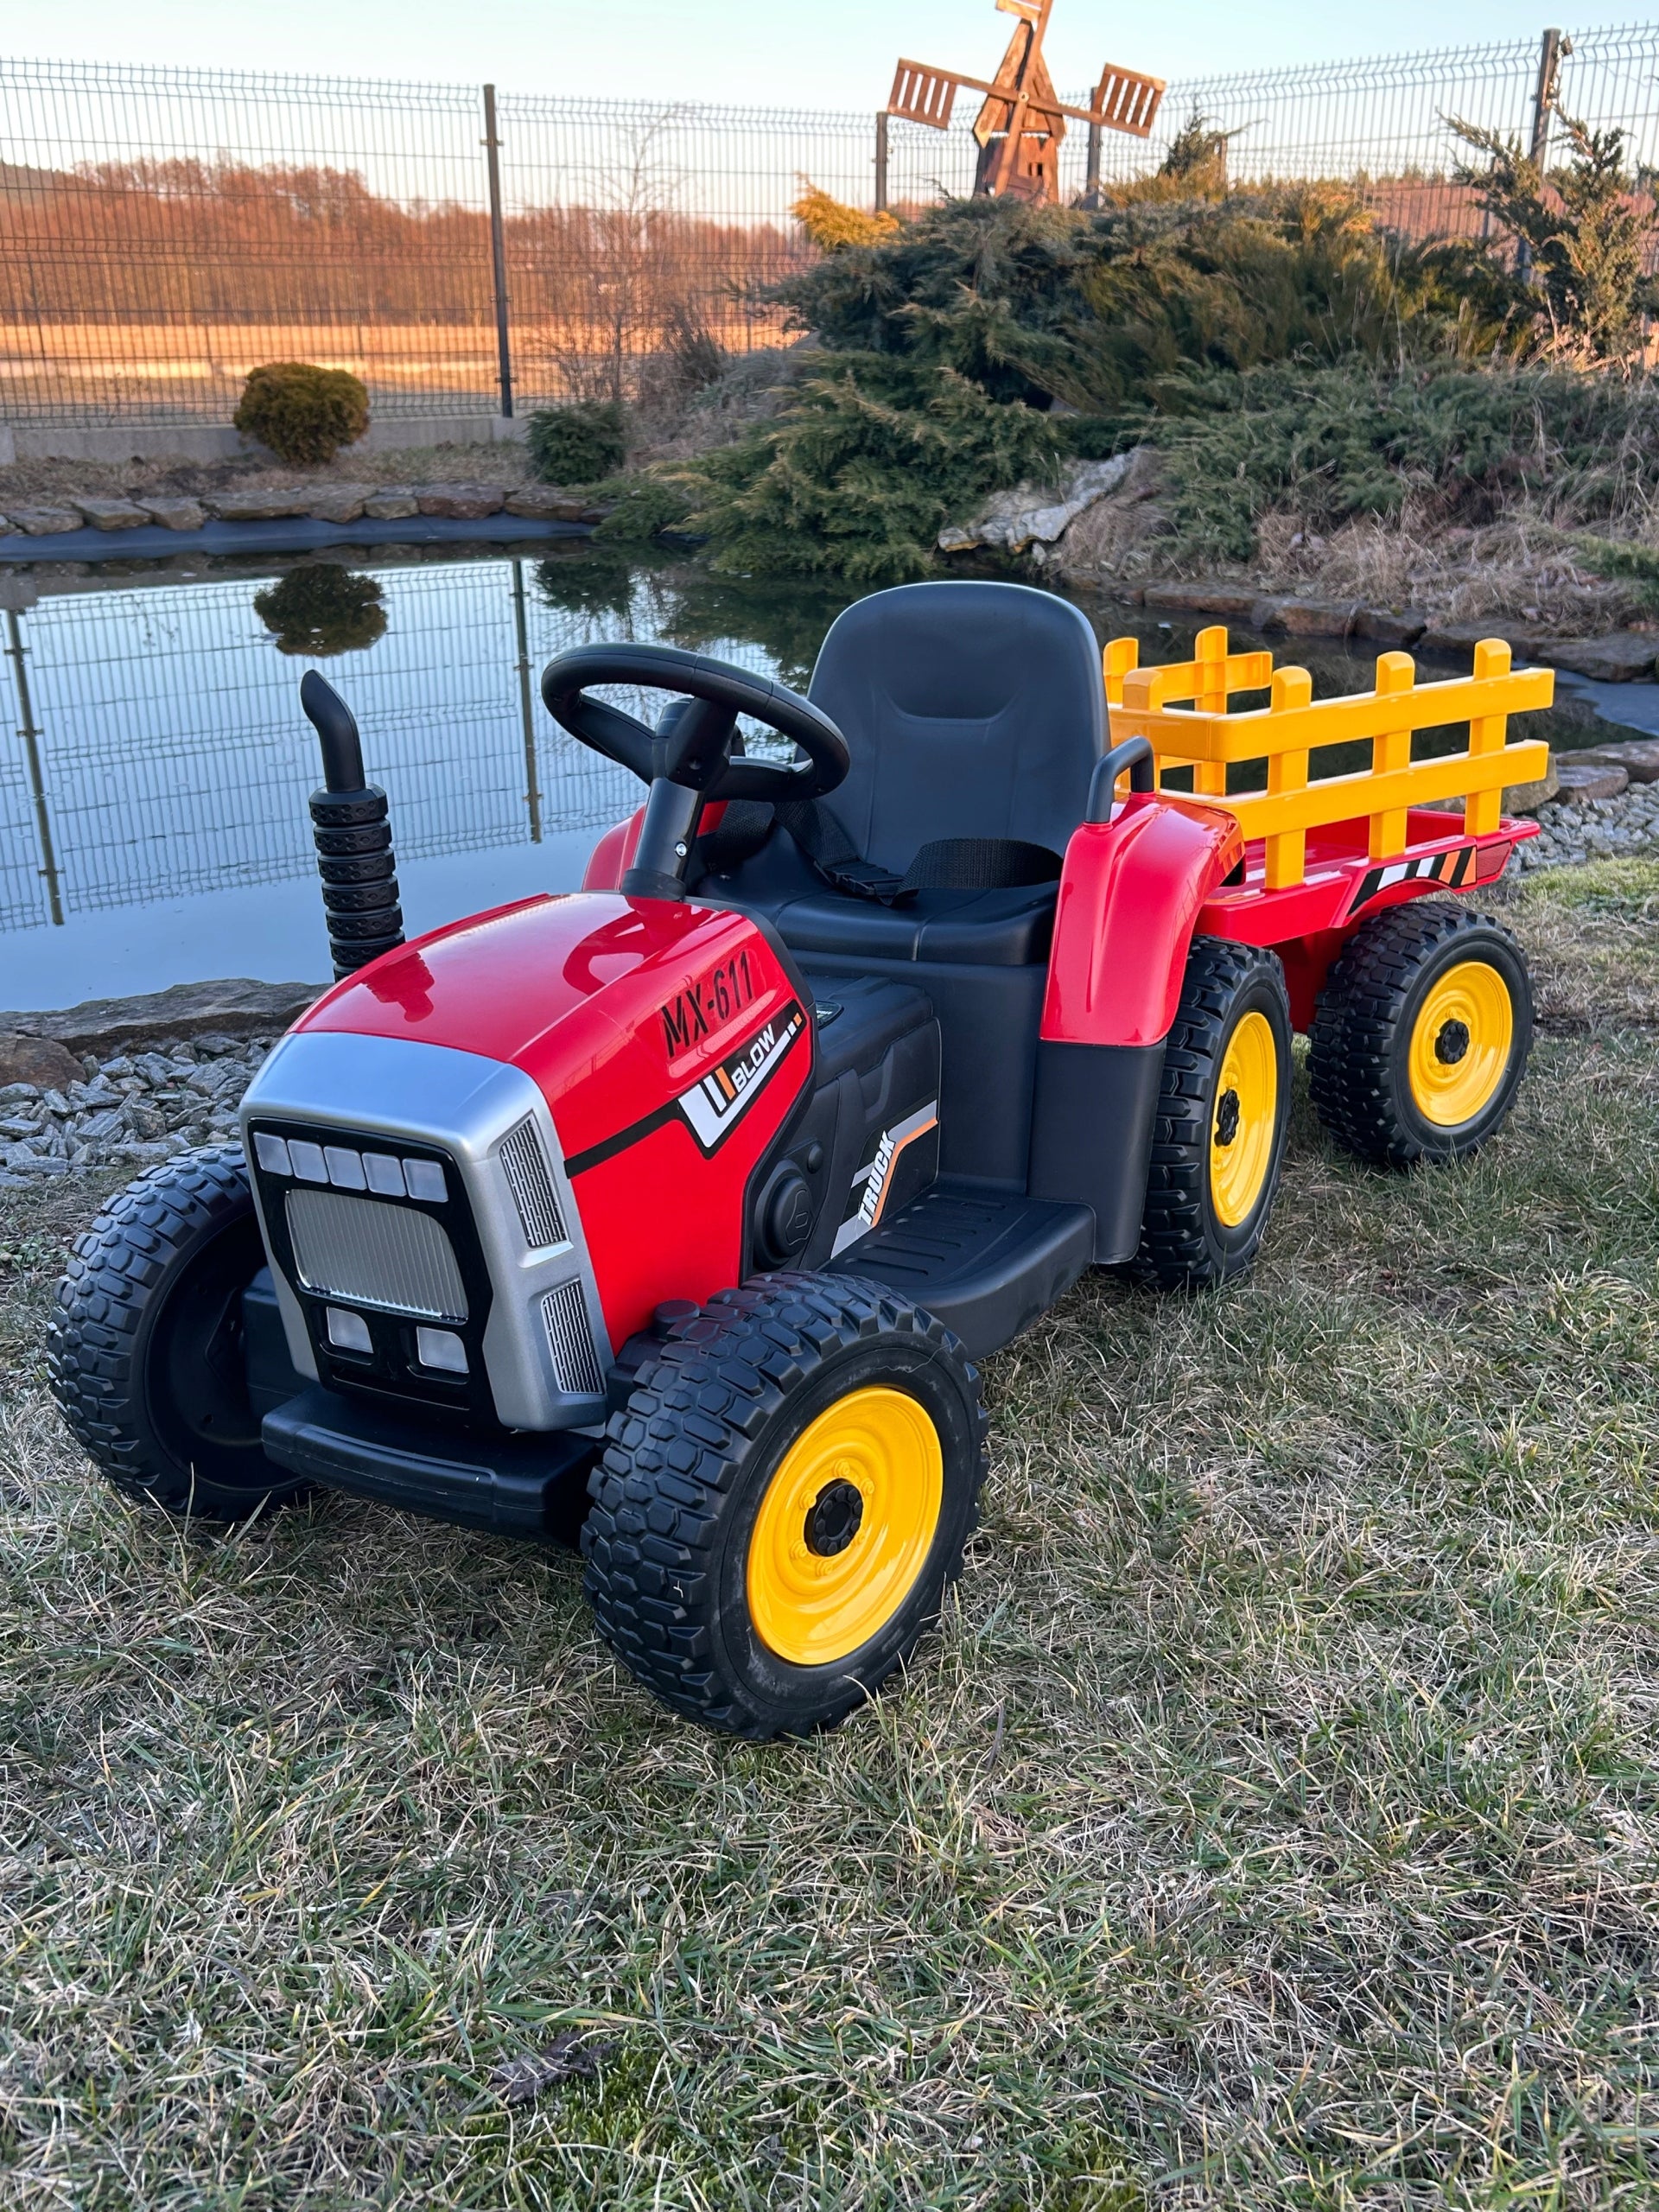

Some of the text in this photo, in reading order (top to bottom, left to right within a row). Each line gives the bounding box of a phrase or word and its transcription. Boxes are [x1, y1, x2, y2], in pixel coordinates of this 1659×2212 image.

[662, 951, 753, 1058] MX-611
[732, 1024, 776, 1093] BLOW
[859, 1131, 895, 1225] TRUCK
